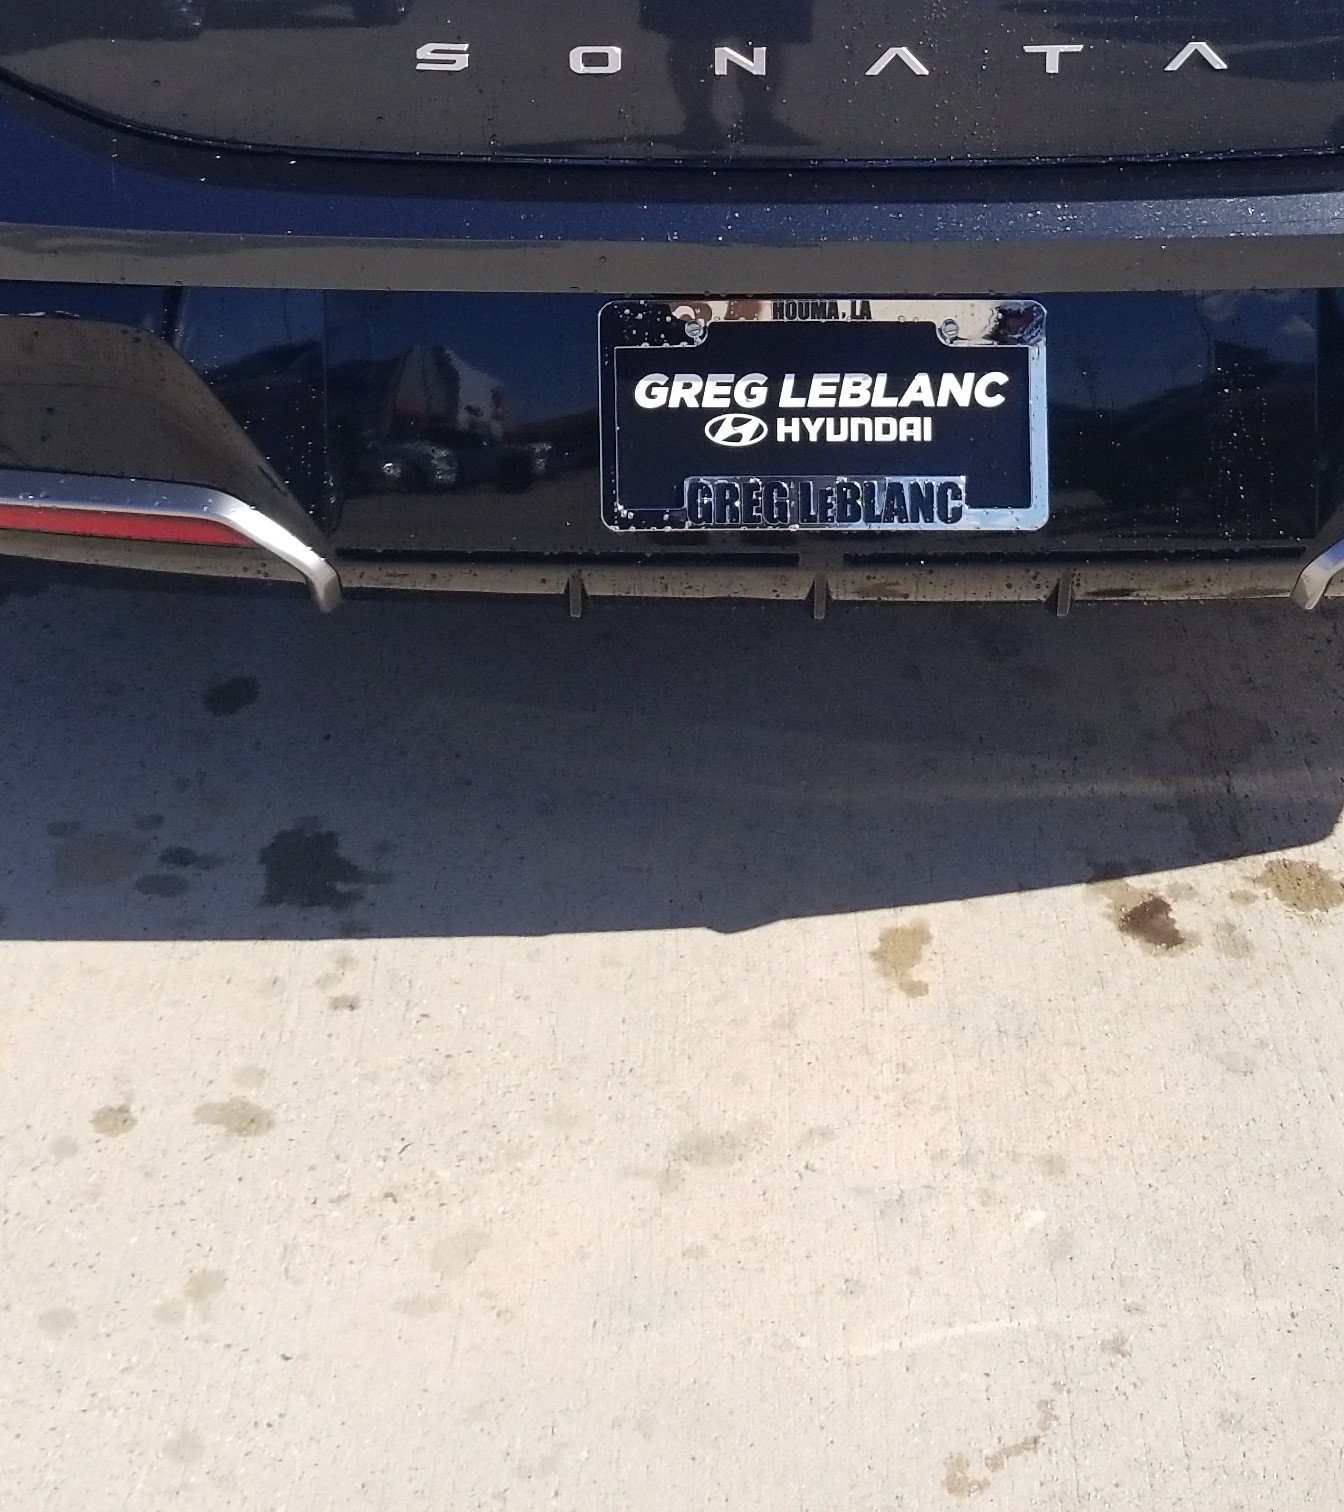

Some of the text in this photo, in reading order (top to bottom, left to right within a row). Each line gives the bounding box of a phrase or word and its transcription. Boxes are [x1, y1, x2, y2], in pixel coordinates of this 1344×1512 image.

[414, 40, 1229, 77] SONATA
[772, 300, 872, 320] HOUMA, LA
[633, 371, 1010, 409] GREG LEBLANC
[776, 416, 932, 442] HYUNDAI
[686, 480, 790, 525] GREG
